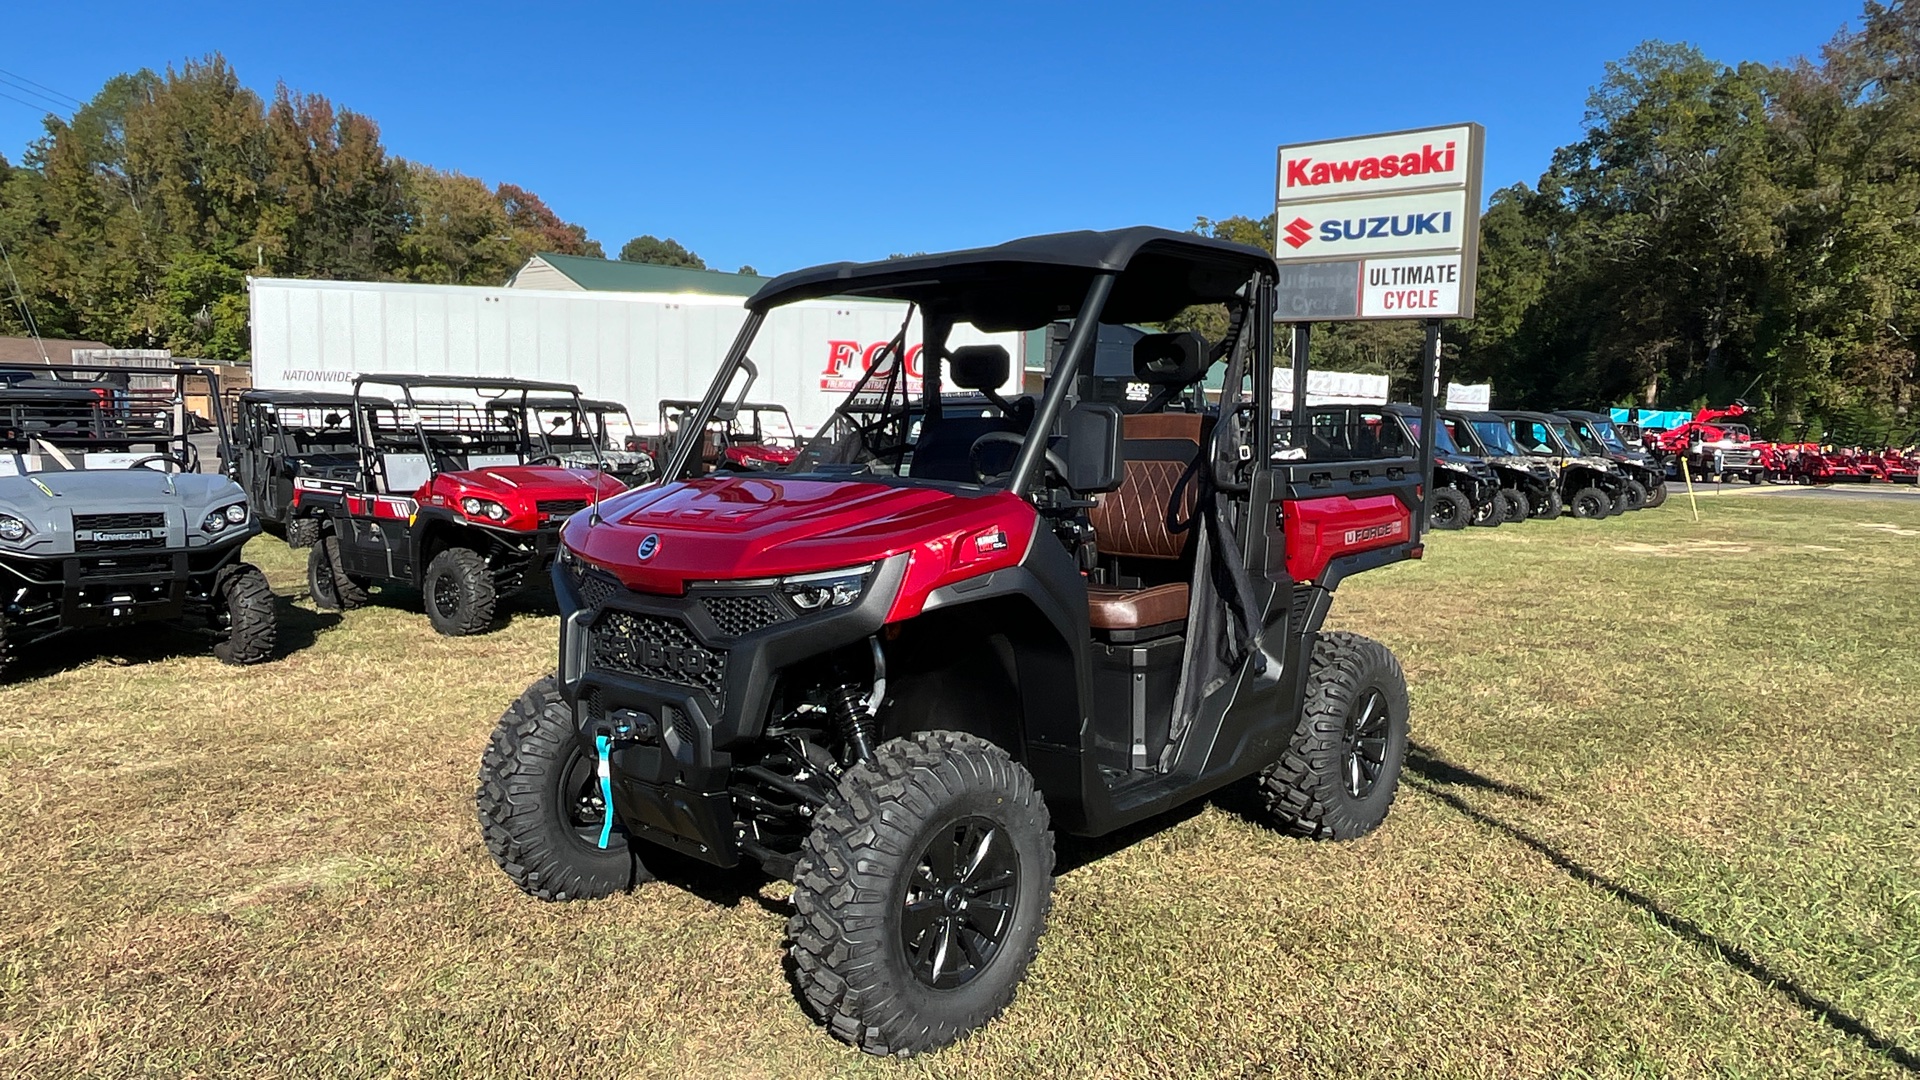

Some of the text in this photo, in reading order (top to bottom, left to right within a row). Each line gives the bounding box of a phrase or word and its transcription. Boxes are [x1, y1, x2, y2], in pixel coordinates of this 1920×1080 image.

[1286, 141, 1456, 188] Kawasaki
[1319, 211, 1452, 242] SUZUKI
[1369, 264, 1457, 286] ULTIMATE
[1383, 290, 1439, 310] CYCLE
[282, 369, 353, 383] NATIONWIDE
[93, 530, 152, 542] Kawasaki
